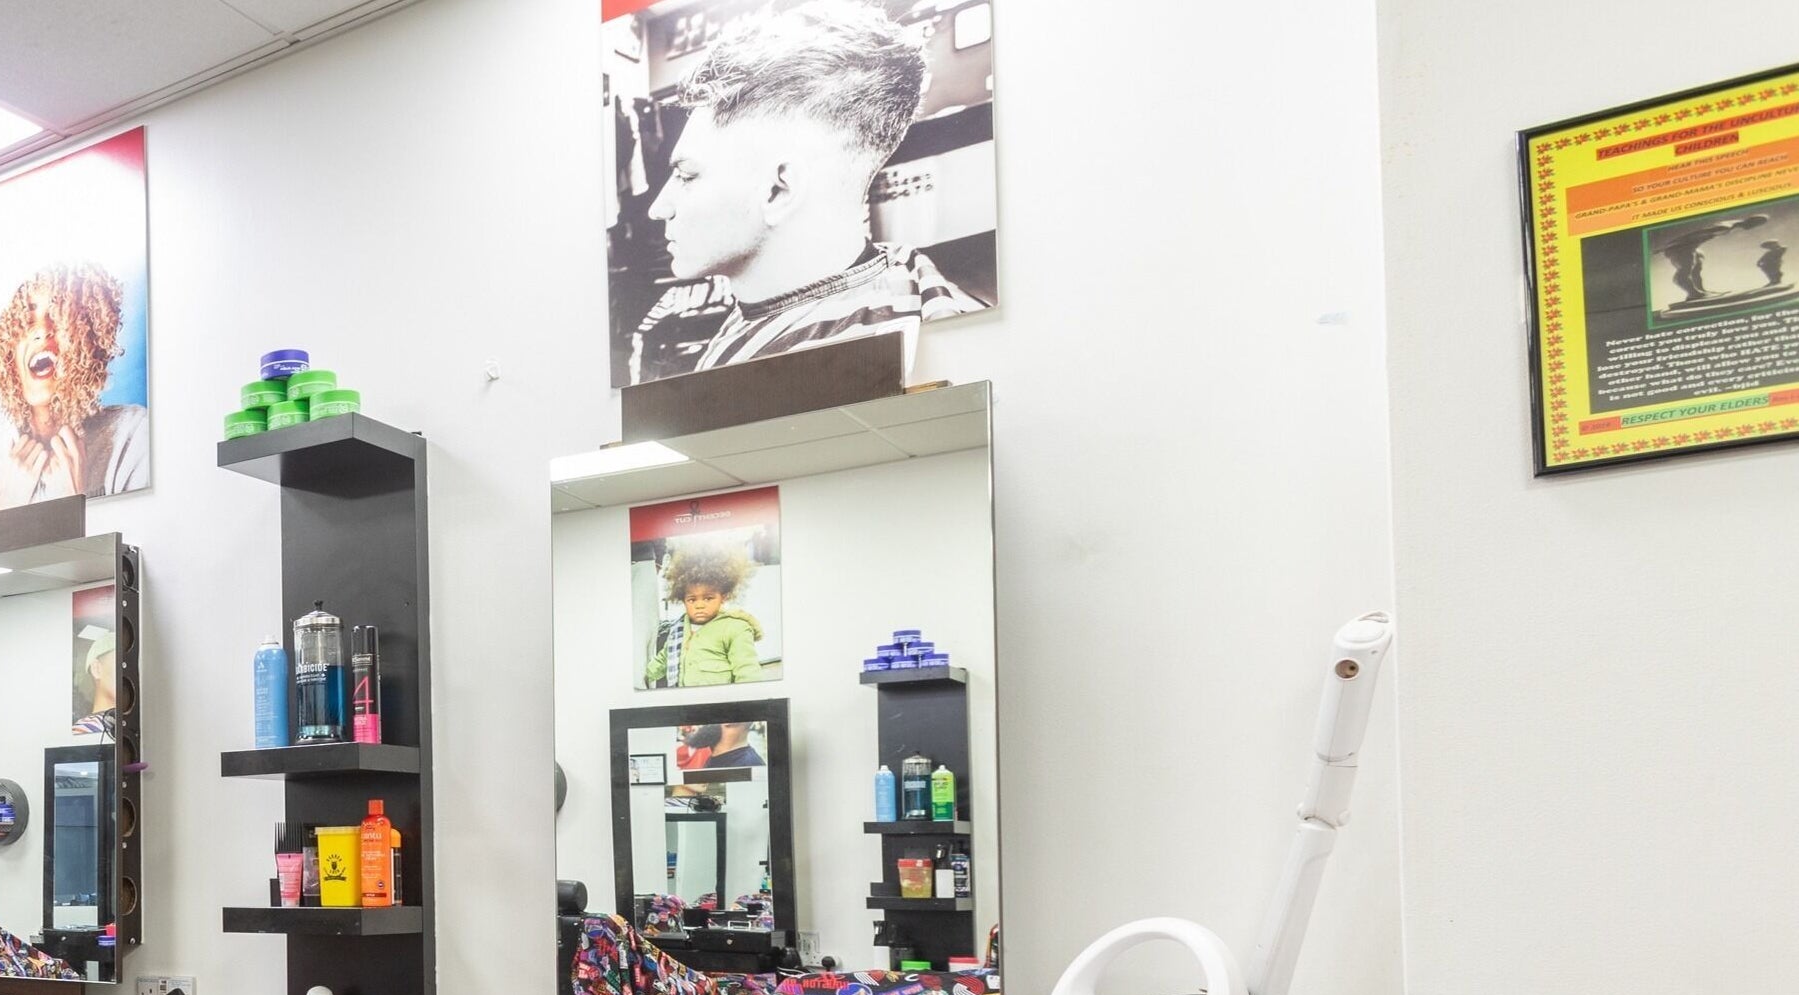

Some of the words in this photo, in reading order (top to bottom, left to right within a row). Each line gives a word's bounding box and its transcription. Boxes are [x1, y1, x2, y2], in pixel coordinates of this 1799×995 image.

[1599, 136, 1668, 158] TEACHINGS
[1671, 128, 1698, 142] FOR
[1703, 121, 1725, 136] THE
[1675, 133, 1739, 155] CHILDREN
[1694, 156, 1715, 166] THIS
[1716, 149, 1750, 162] SPEECH
[1633, 185, 1645, 193] SO
[1647, 179, 1671, 189] YOUR
[1672, 170, 1712, 185] CULTURE
[1714, 166, 1735, 175] YOU
[1736, 161, 1757, 171] CAN
[1725, 172, 1773, 187] DISCIPLINE
[1631, 213, 1641, 221] IT
[1642, 208, 1668, 219] MADE
[1670, 204, 1683, 213] US
[1684, 193, 1736, 210] CONSCIOUS
[1606, 335, 1643, 348] Never
[1645, 330, 1675, 341] hate
[1676, 318, 1749, 335] correction,
[1751, 312, 1774, 322] for
[1607, 350, 1654, 362] willing
[1655, 347, 1670, 355] to
[1671, 337, 1733, 352] displease
[1734, 332, 1759, 342] you
[1761, 326, 1788, 337] and
[1609, 341, 1656, 354] correct
[1658, 338, 1683, 348] you
[1721, 325, 1750, 335] love
[1624, 358, 1655, 369] your
[1656, 346, 1726, 363] friendship
[1727, 338, 1772, 351] rather
[1665, 357, 1706, 369] Those
[1707, 352, 1738, 361] who
[1740, 343, 1780, 356] HATE
[1598, 382, 1647, 395] because
[1649, 376, 1682, 387] what
[1685, 373, 1703, 381] do
[1704, 368, 1735, 379] they
[1607, 375, 1643, 386] other
[1644, 369, 1682, 380] hand,
[1684, 363, 1712, 373] will
[1713, 357, 1752, 369] allow
[1754, 353, 1780, 363] you
[1622, 391, 1646, 400] not
[1646, 384, 1679, 396] good
[1680, 381, 1706, 391] and
[1707, 375, 1745, 387] every
[1621, 409, 1675, 426] RESPECT
[1678, 403, 1717, 417] YOUR
[1720, 395, 1769, 411] ELDERS
